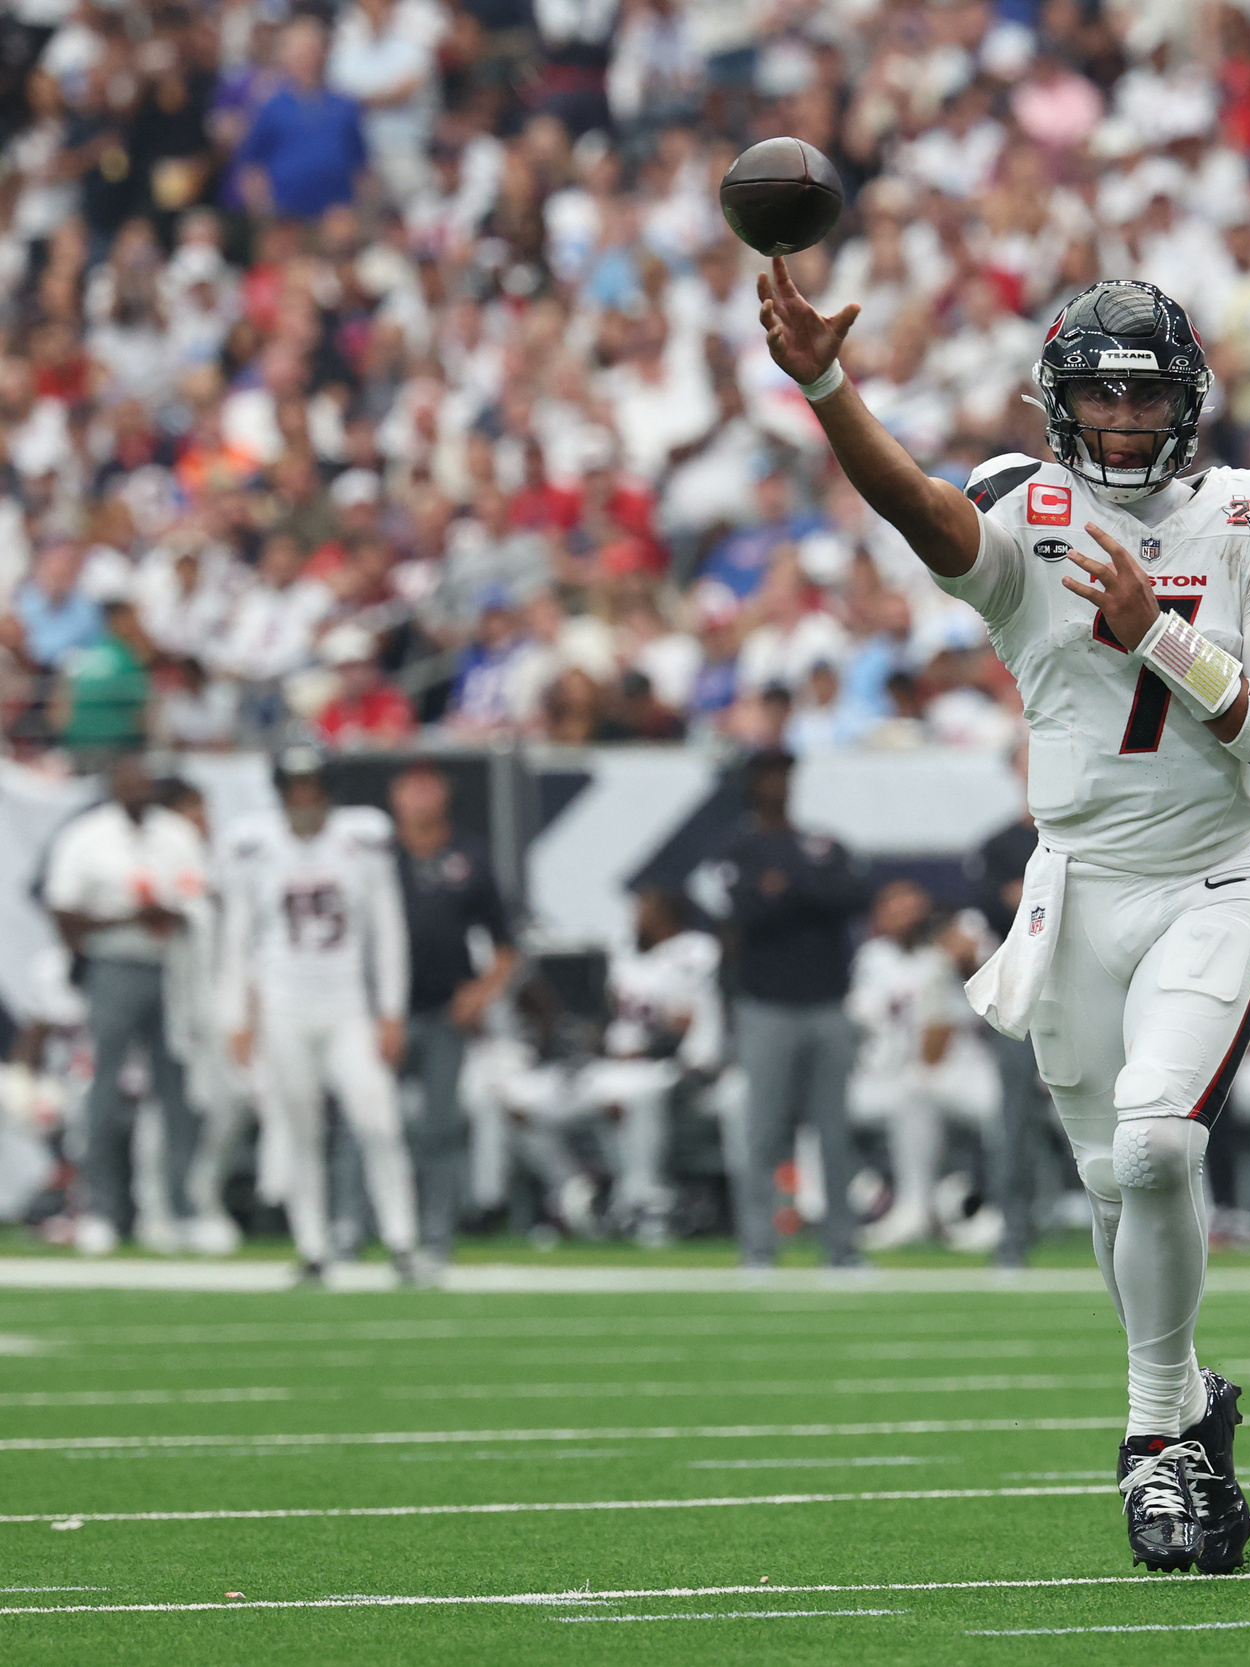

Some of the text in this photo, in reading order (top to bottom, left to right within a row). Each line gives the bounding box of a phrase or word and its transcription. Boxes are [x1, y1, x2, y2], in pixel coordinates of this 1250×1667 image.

[1106, 352, 1152, 360] TEXANS
[1031, 486, 1068, 514] C
[1142, 547, 1159, 558] NFL
[1093, 595, 1203, 755] 7
[1030, 919, 1044, 934] NFL
